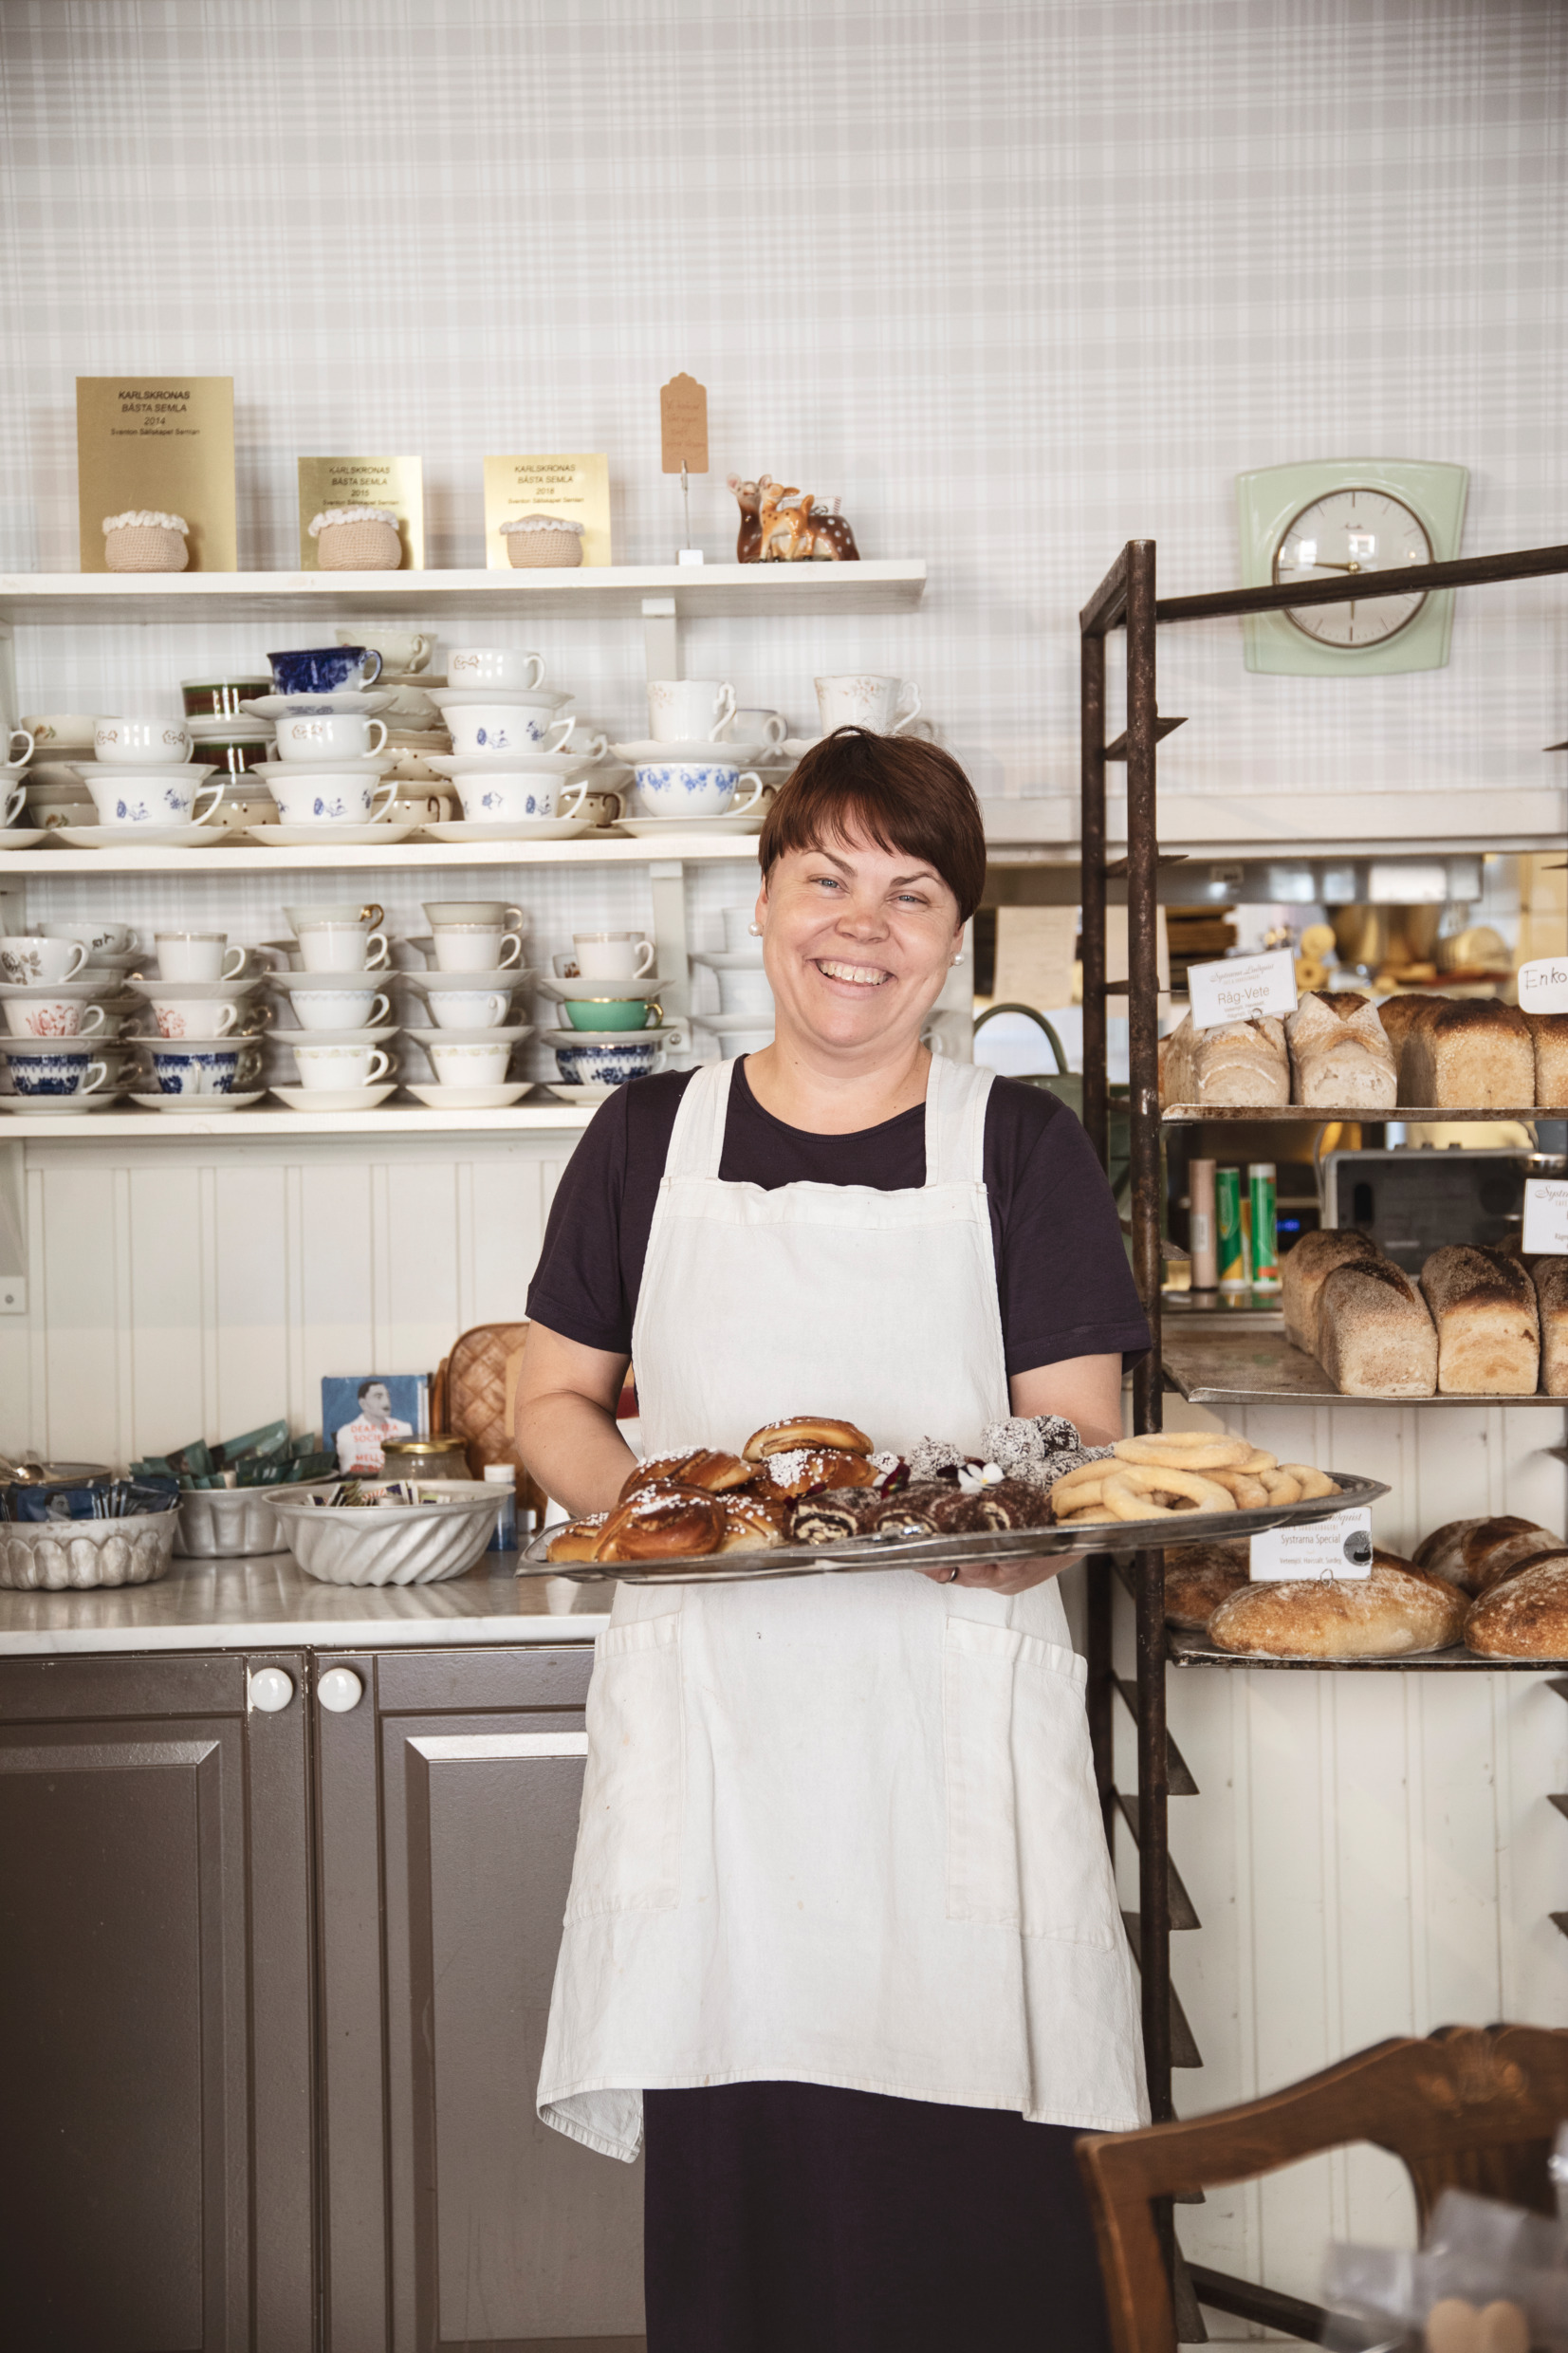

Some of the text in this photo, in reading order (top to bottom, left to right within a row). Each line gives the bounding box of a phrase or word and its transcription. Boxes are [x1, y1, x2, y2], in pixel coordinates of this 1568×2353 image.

[118, 390, 191, 399] KARLSKRONAS
[121, 402, 187, 413] BÄSTA SEMLA
[143, 417, 166, 425] 2014
[329, 466, 391, 474] KARLSKRONAS
[514, 464, 577, 472] KARLSKRONAS
[331, 477, 359, 486] BÄSTA
[517, 475, 574, 484] BÄSTA SEMLA
[1217, 986, 1270, 1006] Råg-Vete
[1315, 1533, 1340, 1546] Special
